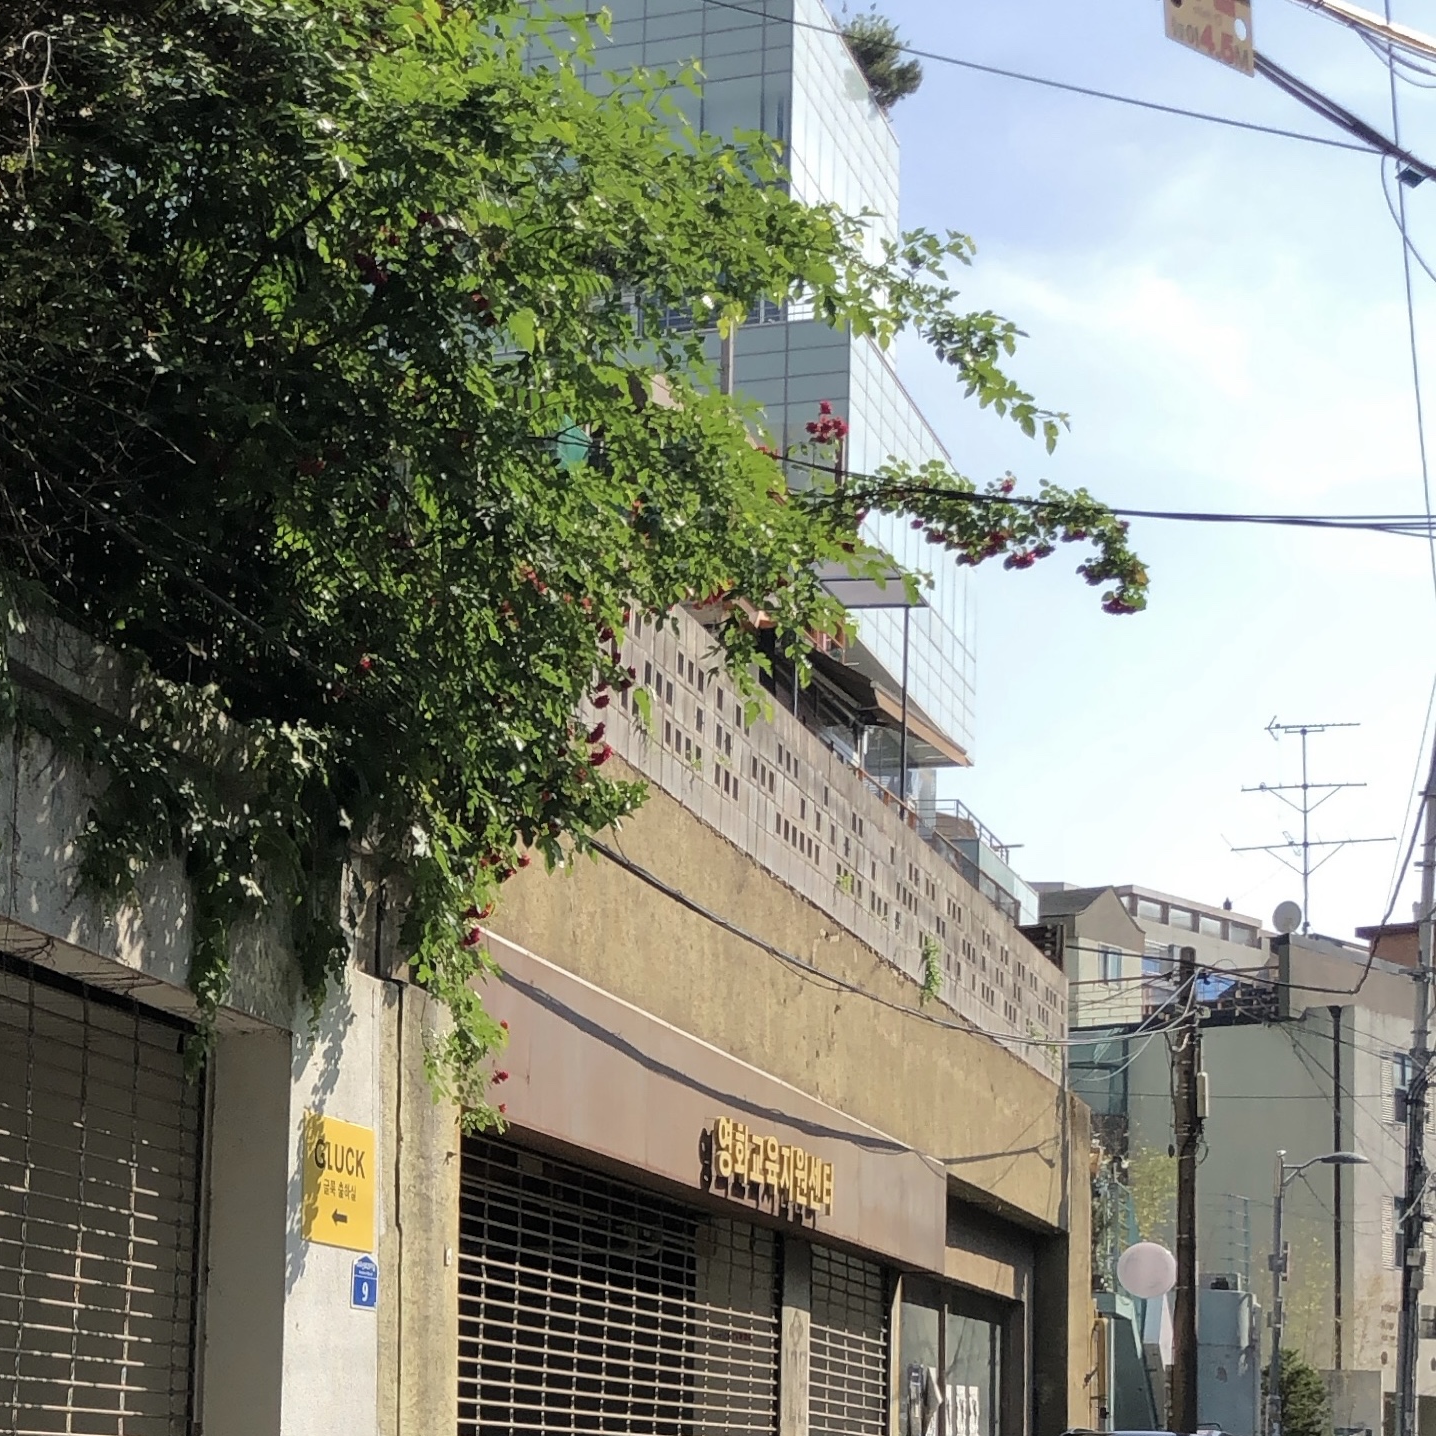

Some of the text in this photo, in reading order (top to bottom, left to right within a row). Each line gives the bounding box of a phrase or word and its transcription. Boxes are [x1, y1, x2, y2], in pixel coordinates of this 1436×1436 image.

[314, 1138, 366, 1179] GLUCK
[715, 1115, 835, 1217] 영화교육지원센터
[361, 1281, 369, 1302] 9
